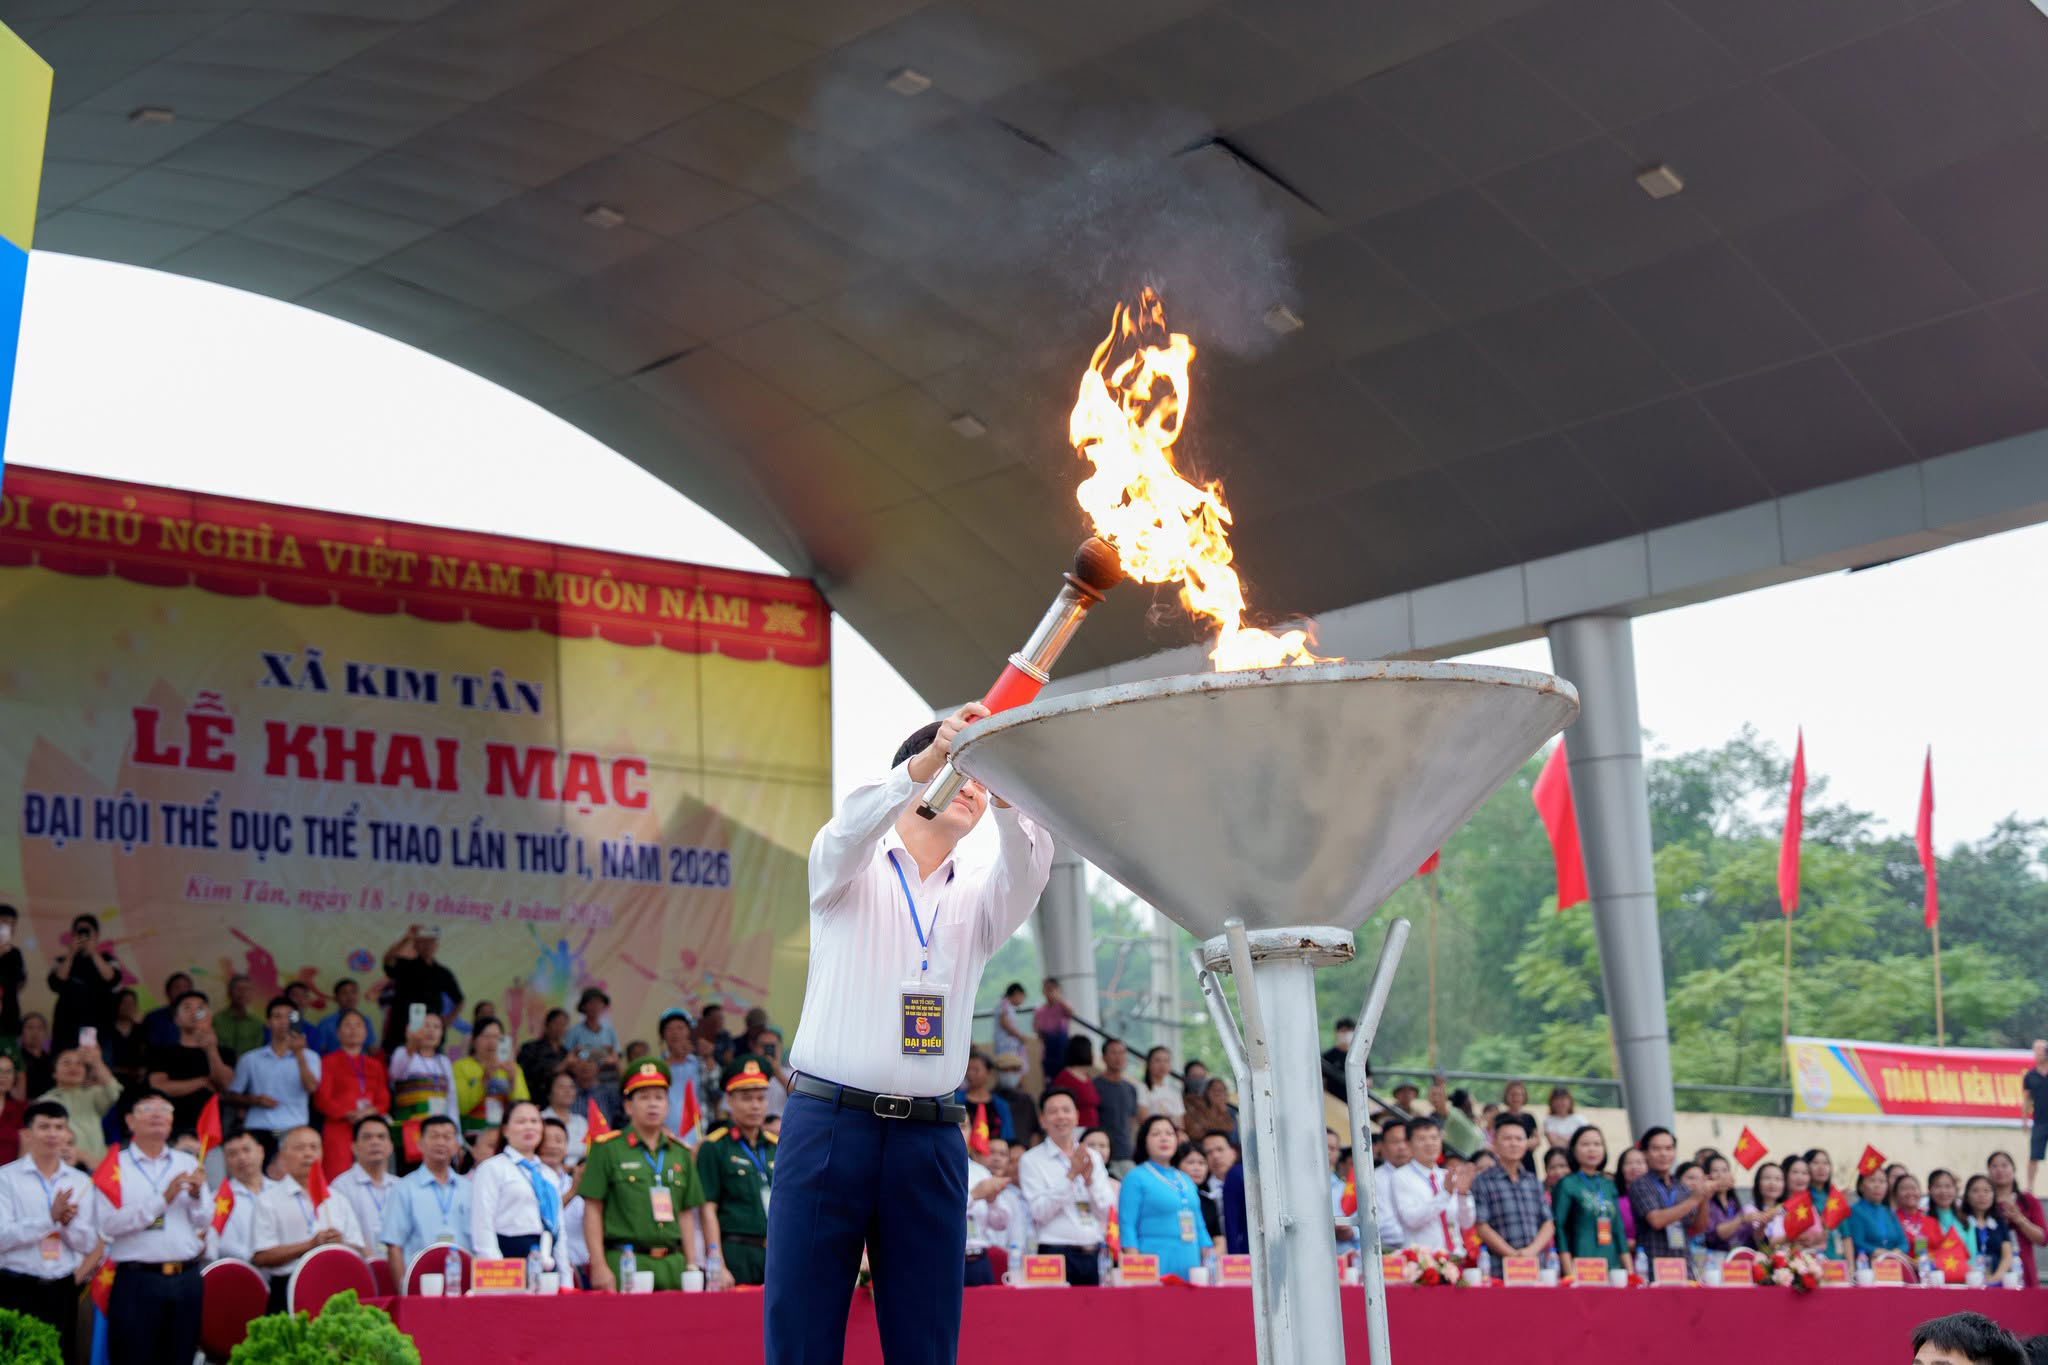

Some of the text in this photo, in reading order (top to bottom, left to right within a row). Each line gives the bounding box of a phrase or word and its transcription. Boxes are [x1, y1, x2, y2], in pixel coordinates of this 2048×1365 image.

[48, 496, 143, 542] CHỦ
[319, 536, 417, 588] VIỆT
[429, 556, 522, 596] NAM
[533, 569, 647, 613] MUÔN
[659, 585, 749, 628] NĂM!
[260, 648, 543, 716] XÃ KIM TÂN
[132, 690, 648, 815] LỄ KHAI MẠC
[24, 792, 82, 847] ĐẠI
[94, 791, 149, 851] HỘI
[160, 790, 219, 848] THỂ
[230, 809, 293, 863] DỤC
[303, 801, 360, 860] THỂ
[369, 822, 441, 864] THAO
[515, 826, 572, 875] THỨ
[575, 837, 593, 882] I,
[600, 834, 663, 883] NĂM
[668, 849, 732, 888] 2026
[186, 875, 232, 899] Kim
[242, 878, 291, 907] Tân,
[297, 885, 351, 912] ngày
[359, 886, 384, 911] 18
[405, 890, 430, 914] 19
[434, 895, 494, 923] tháng
[905, 1036, 941, 1048] ĐẠI BIỂU
